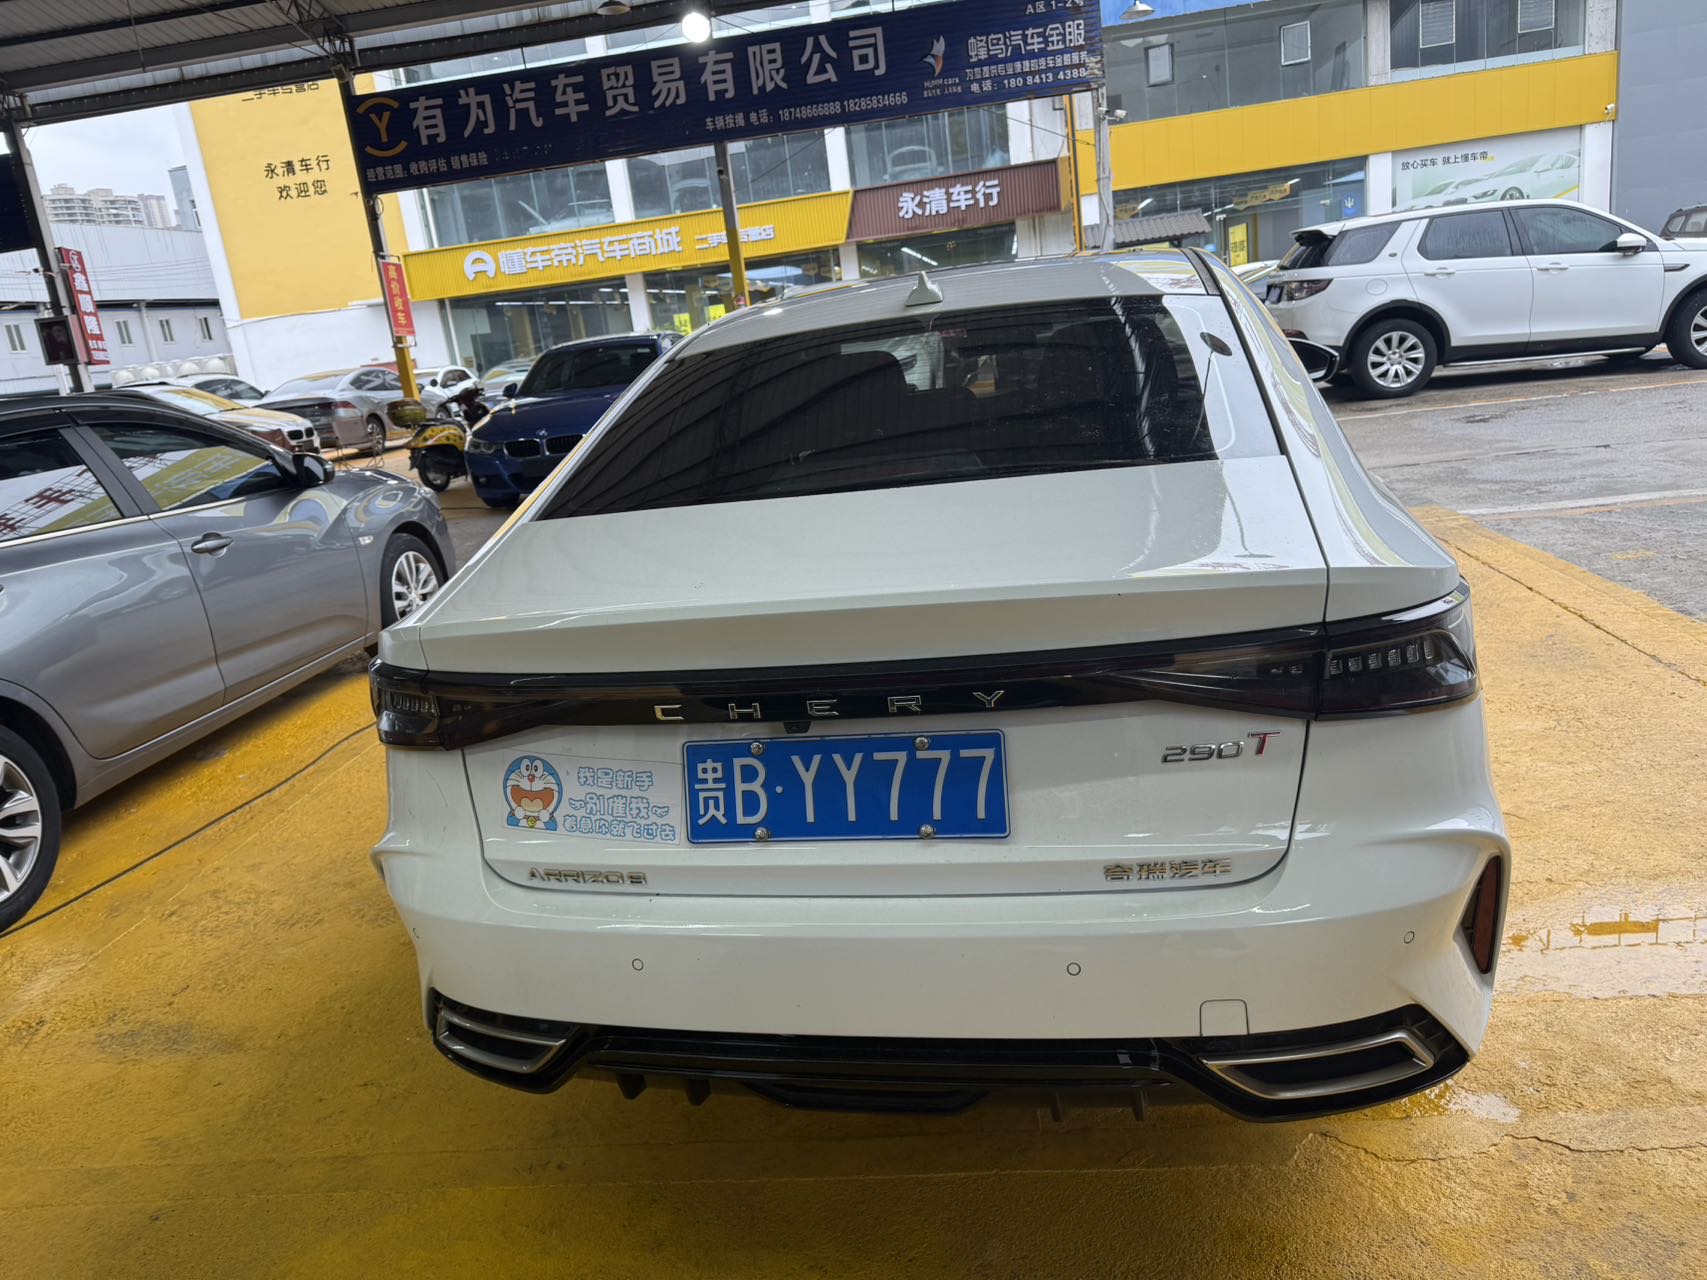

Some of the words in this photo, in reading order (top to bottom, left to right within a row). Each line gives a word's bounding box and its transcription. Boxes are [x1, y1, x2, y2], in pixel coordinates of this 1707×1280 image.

[1026, 1, 1046, 15] A区
[967, 19, 1085, 62] 蜂鸟汽车金服
[409, 26, 886, 146] 有为汽车贸易有限公司
[1003, 77, 1023, 89] 180
[1026, 73, 1053, 86] 8413
[1058, 67, 1086, 81] 4388
[778, 101, 841, 121] 18748666888
[843, 91, 908, 113] 18285834666
[264, 154, 330, 179] 永清车行
[1401, 157, 1438, 171] 放心买车
[1442, 151, 1489, 166] 就上懂车帝
[276, 179, 328, 200] 欢迎您
[898, 179, 1000, 219] 永清车行
[498, 226, 683, 275] 懂车帝汽车商城
[654, 690, 1005, 721] CHERY
[1161, 731, 1281, 763] 290T
[577, 766, 654, 791] 我是新手
[585, 792, 650, 820] 别催我
[563, 814, 676, 841] 着急你就飞过去
[1103, 857, 1232, 881] 奇瑞汽车
